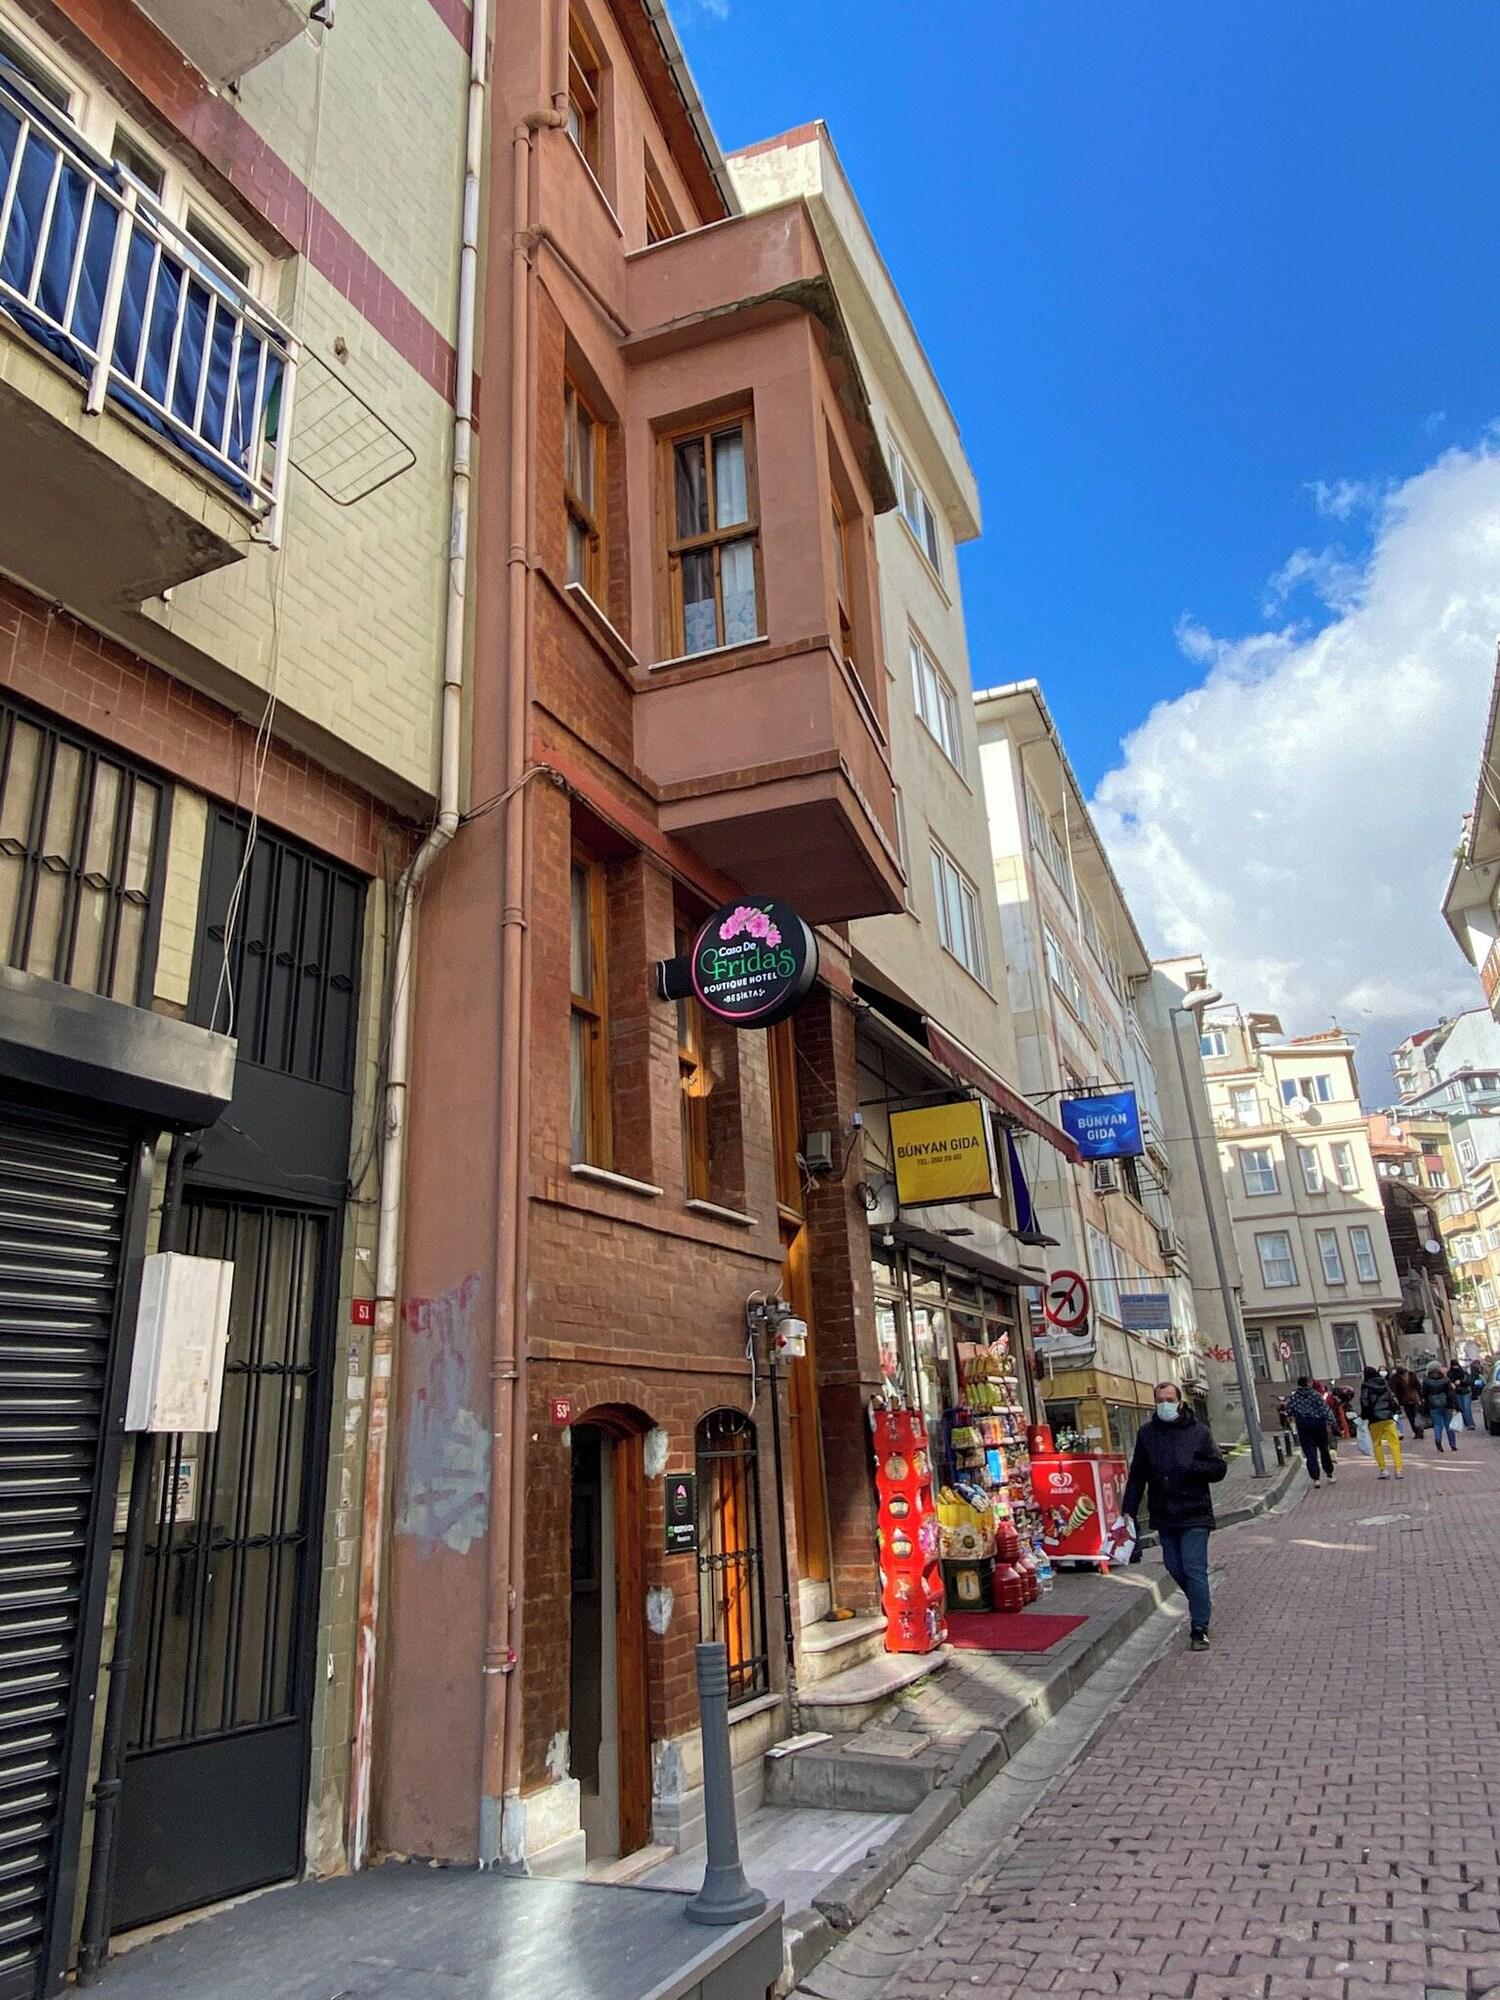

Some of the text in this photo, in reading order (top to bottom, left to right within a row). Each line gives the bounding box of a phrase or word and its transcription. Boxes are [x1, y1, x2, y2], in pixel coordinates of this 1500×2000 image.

[719, 941, 757, 957] Casa De
[701, 945, 795, 980] Frida's
[704, 972, 777, 994] BOUTIQUE HOTEL
[1078, 1113, 1127, 1128] BÜNYAN
[1087, 1127, 1116, 1140] GIDA
[897, 1135, 980, 1159] BÜNYAN GIDA
[359, 1305, 370, 1319] 51
